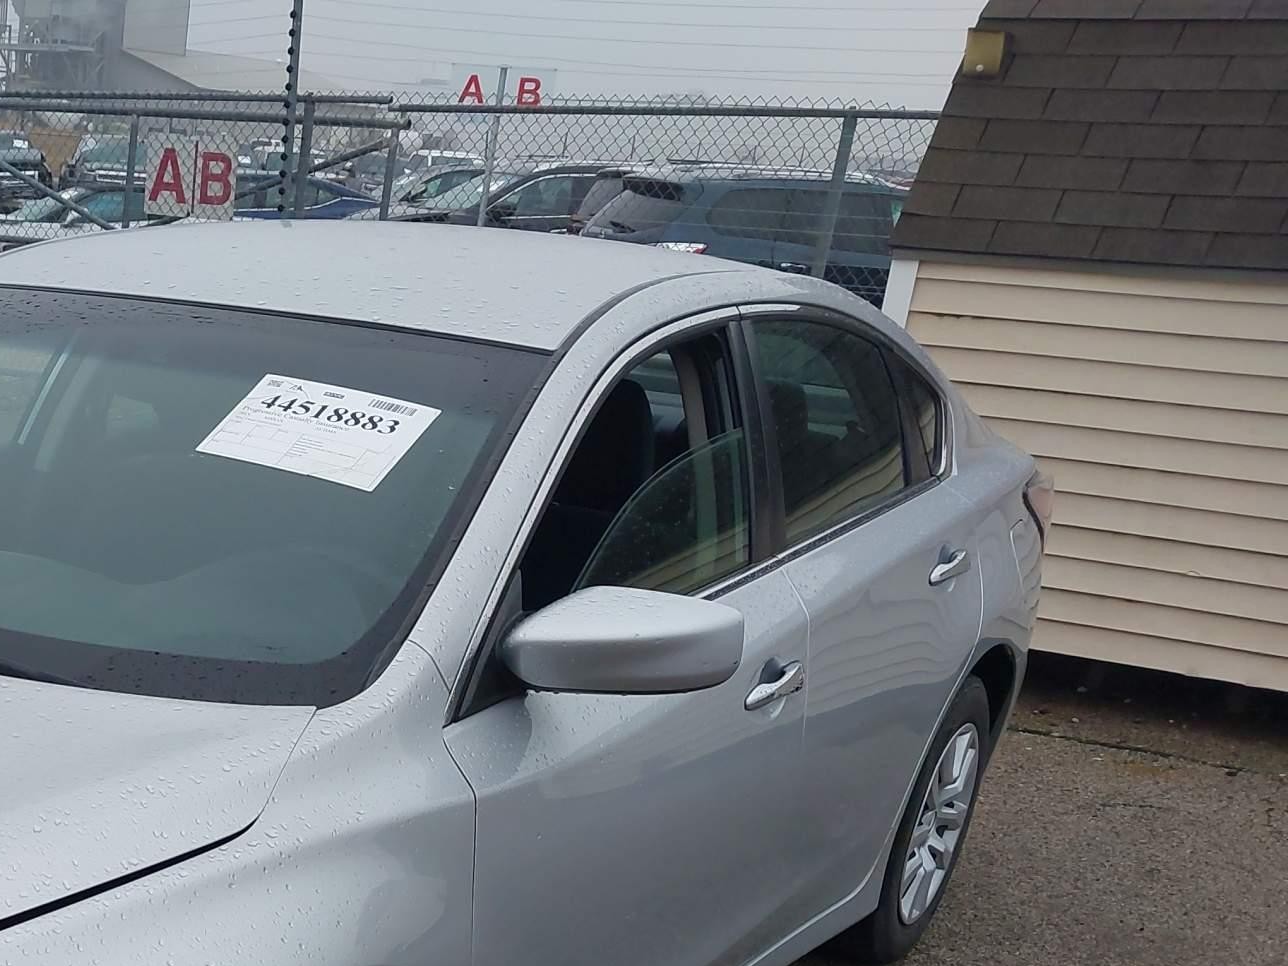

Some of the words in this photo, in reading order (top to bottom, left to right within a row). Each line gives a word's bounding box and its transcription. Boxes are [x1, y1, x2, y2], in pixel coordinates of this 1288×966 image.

[459, 74, 484, 104] A
[516, 78, 542, 107] B
[148, 148, 186, 204] A
[198, 152, 232, 206] B
[261, 393, 400, 435] 44518883
